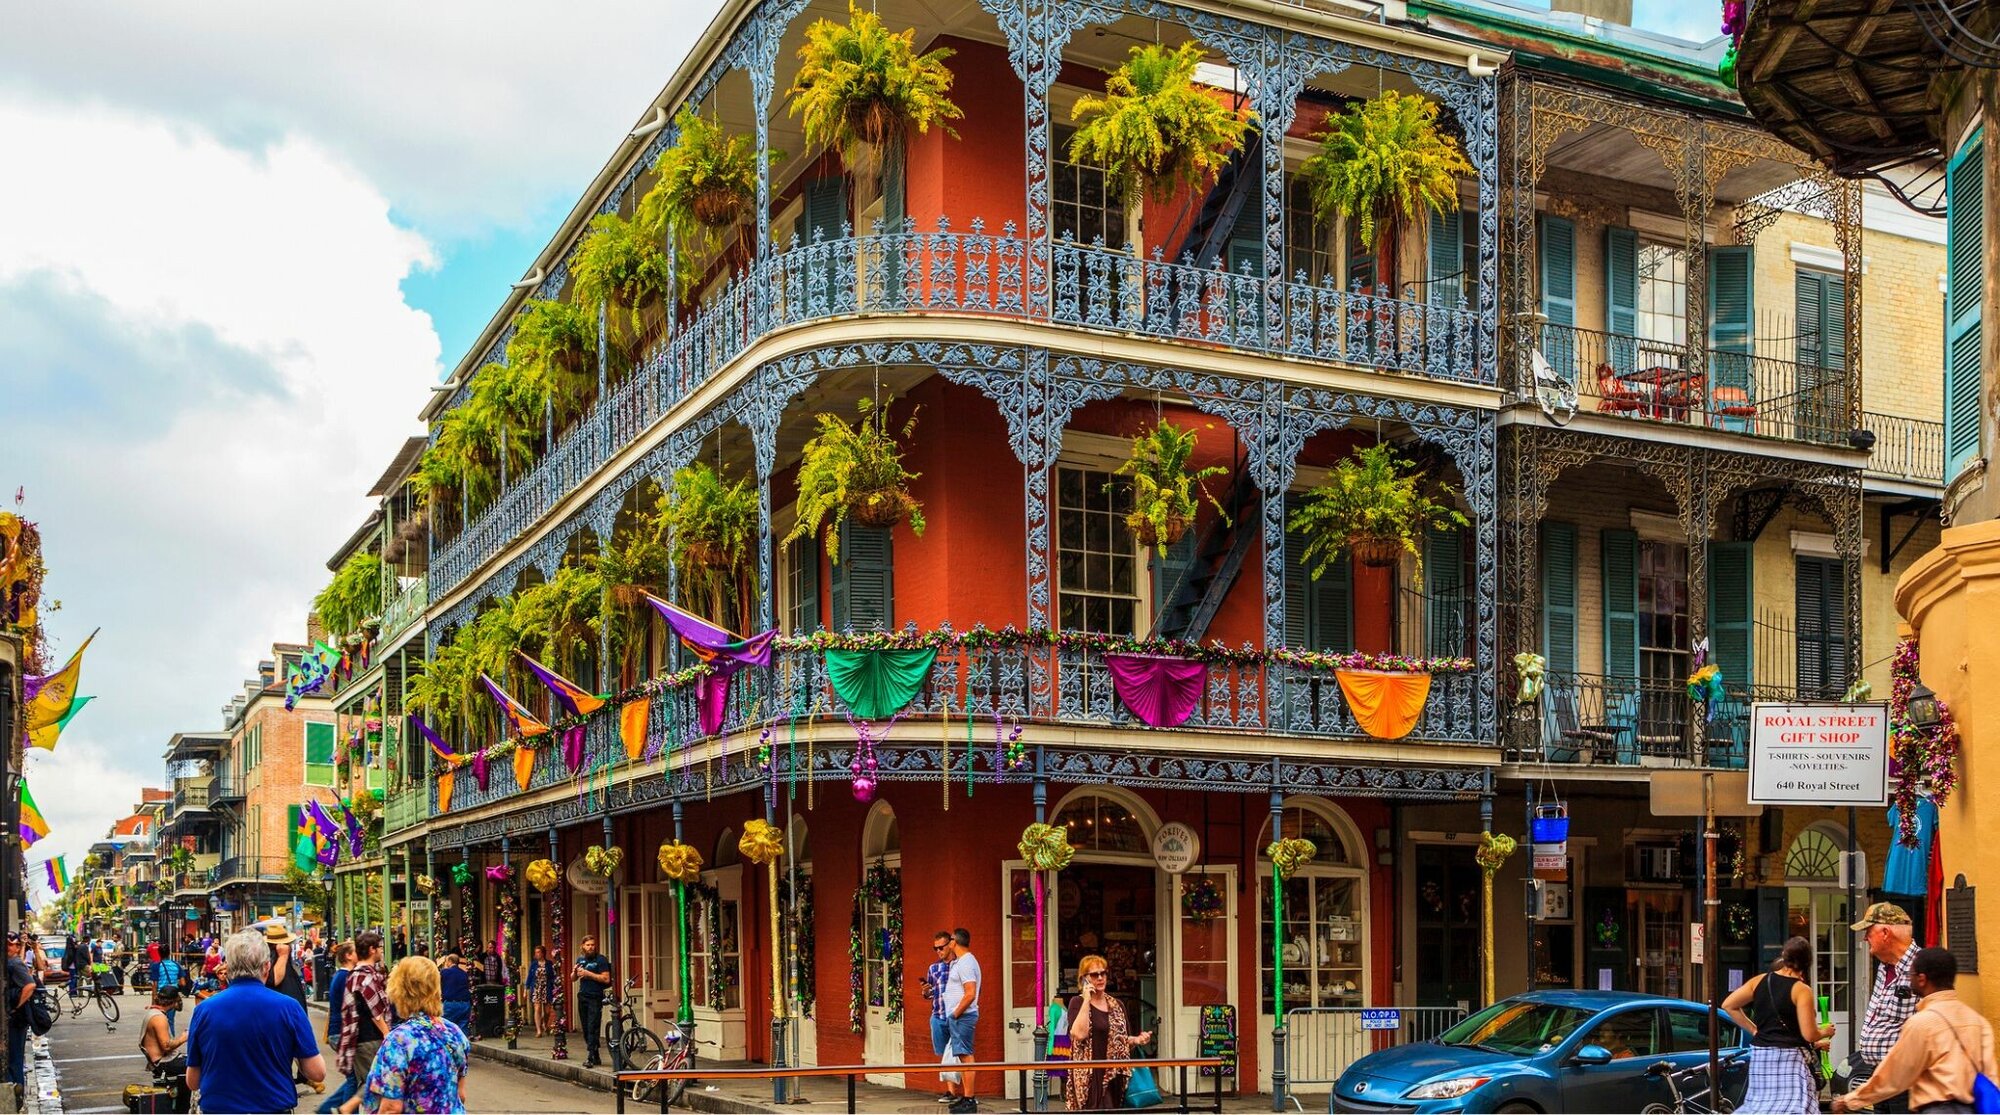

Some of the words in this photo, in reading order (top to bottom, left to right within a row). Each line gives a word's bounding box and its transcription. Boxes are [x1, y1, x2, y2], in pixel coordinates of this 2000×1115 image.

[1765, 716, 1816, 727] ROYAL
[1818, 716, 1877, 727] STREET
[1780, 732, 1816, 743] GIFT
[1819, 733, 1860, 743] SHOP
[1776, 781, 1794, 790] 640
[1797, 781, 1827, 792] Royal
[1829, 781, 1860, 791] Street
